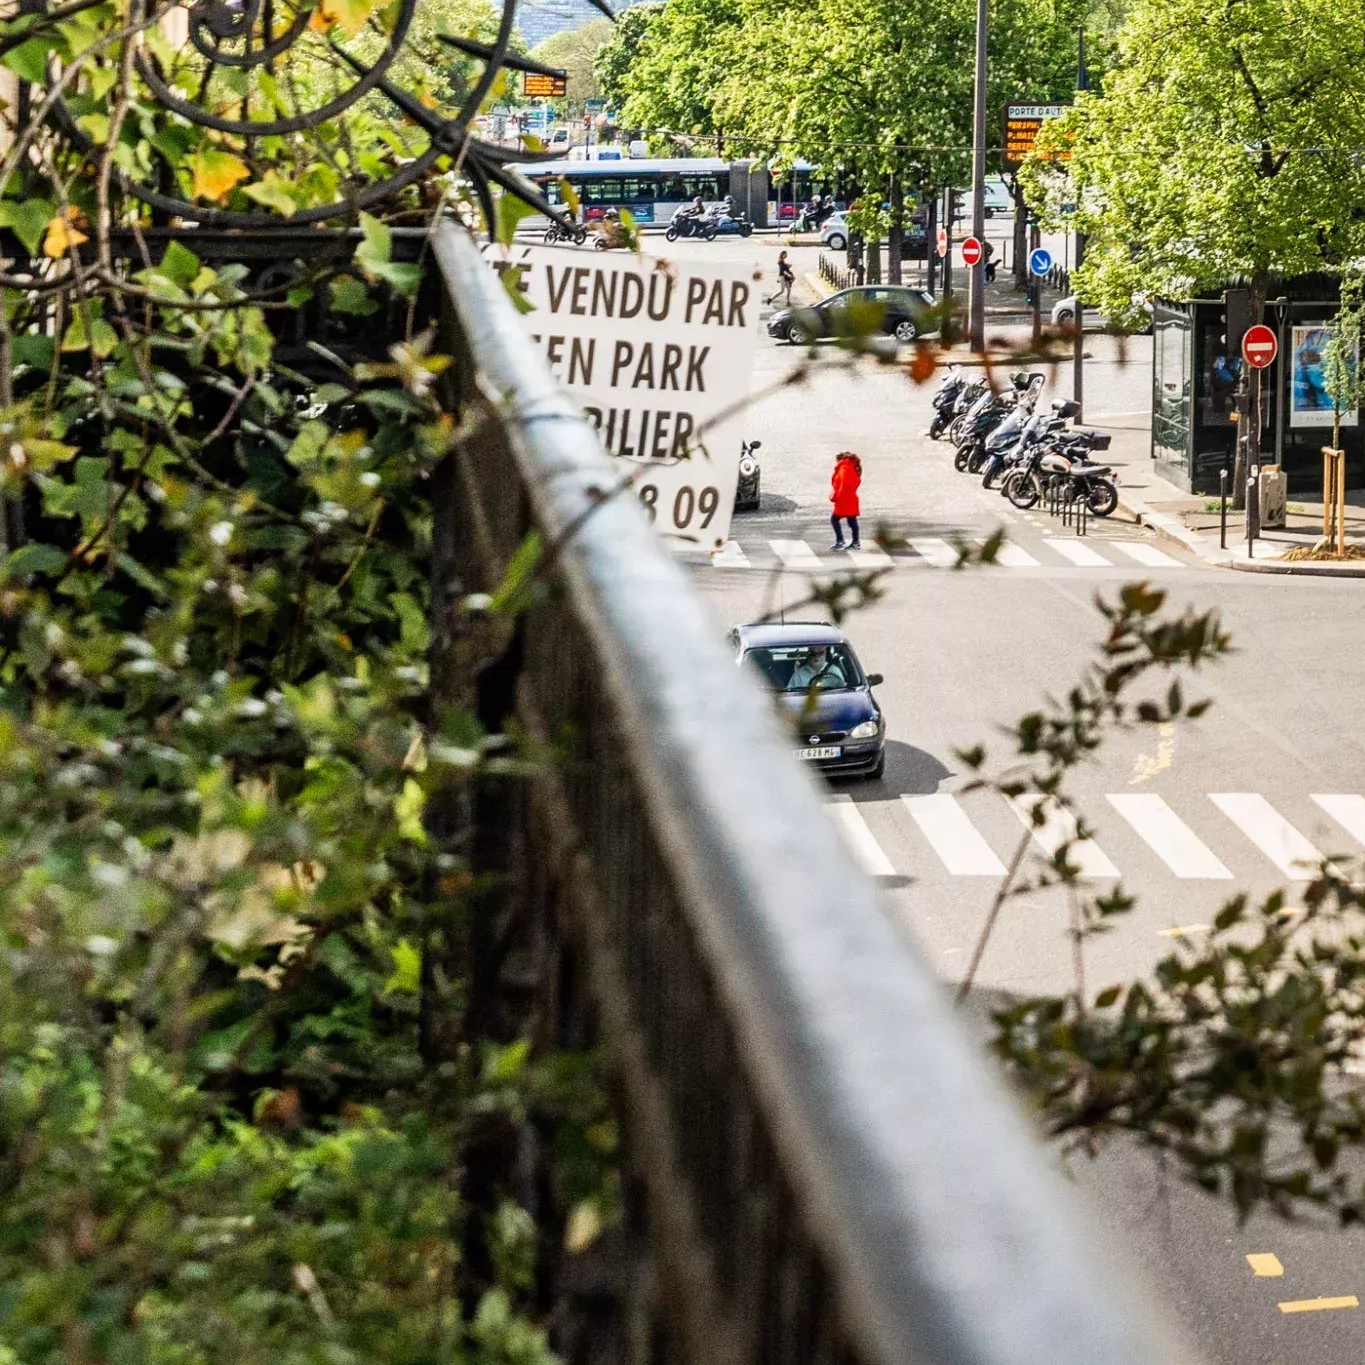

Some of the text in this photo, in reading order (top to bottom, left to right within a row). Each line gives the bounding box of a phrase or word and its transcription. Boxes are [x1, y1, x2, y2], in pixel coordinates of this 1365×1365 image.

[546, 265, 671, 322] VENDU
[684, 277, 749, 327] PAR
[611, 340, 711, 392] PARK
[673, 484, 719, 529] 09
